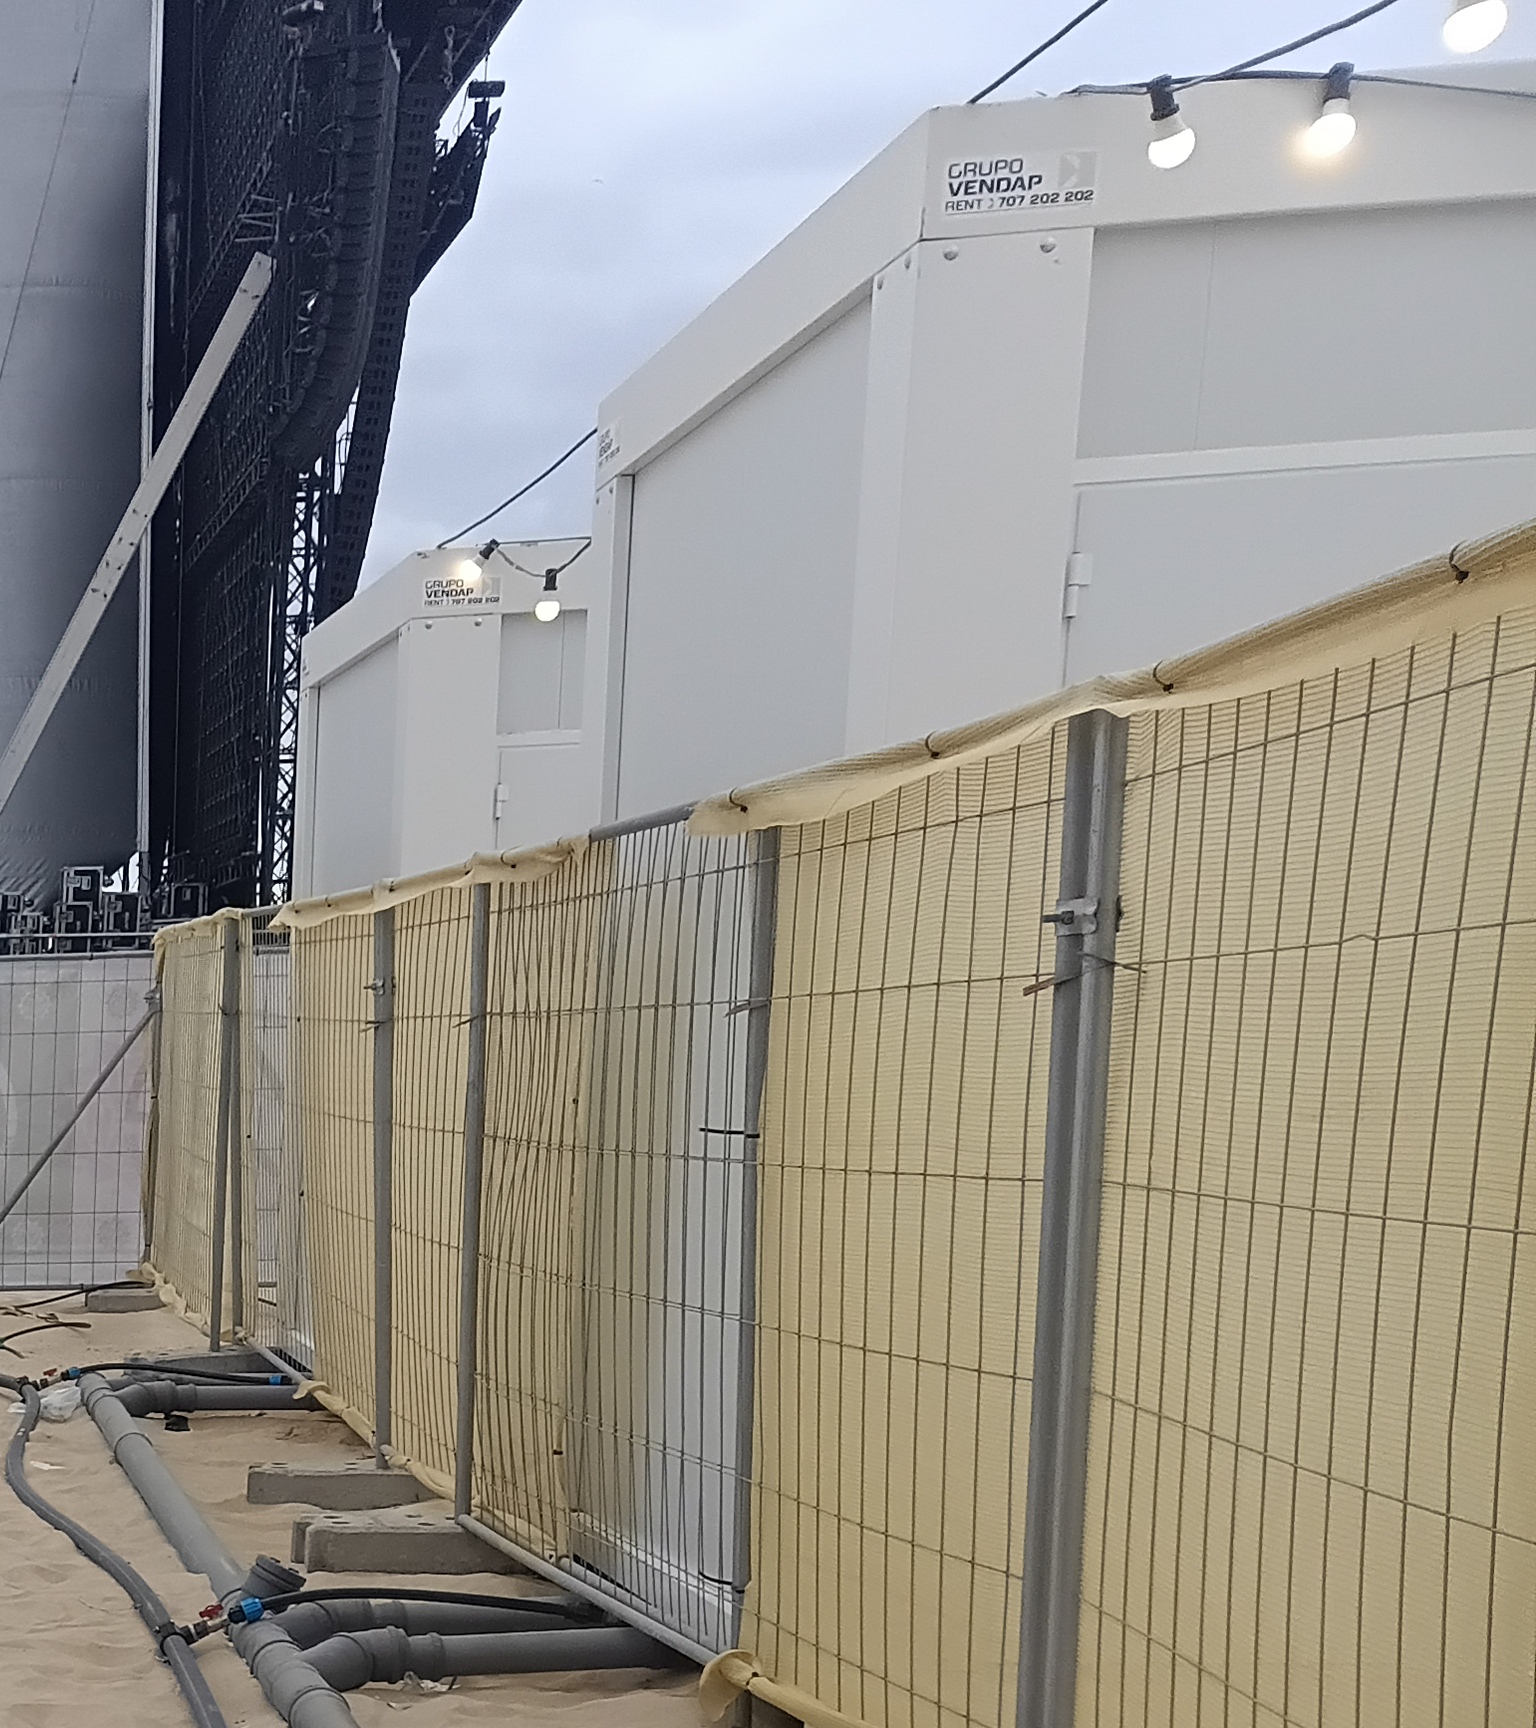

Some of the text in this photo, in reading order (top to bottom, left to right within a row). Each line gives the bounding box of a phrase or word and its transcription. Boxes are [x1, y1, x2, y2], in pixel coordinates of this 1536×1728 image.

[948, 158, 1024, 179] GRUPO
[948, 175, 1043, 197] VENDAP
[945, 189, 1094, 212] RENT 707 202 202
[425, 579, 464, 590] GRUPO
[425, 588, 474, 598] VENDAP
